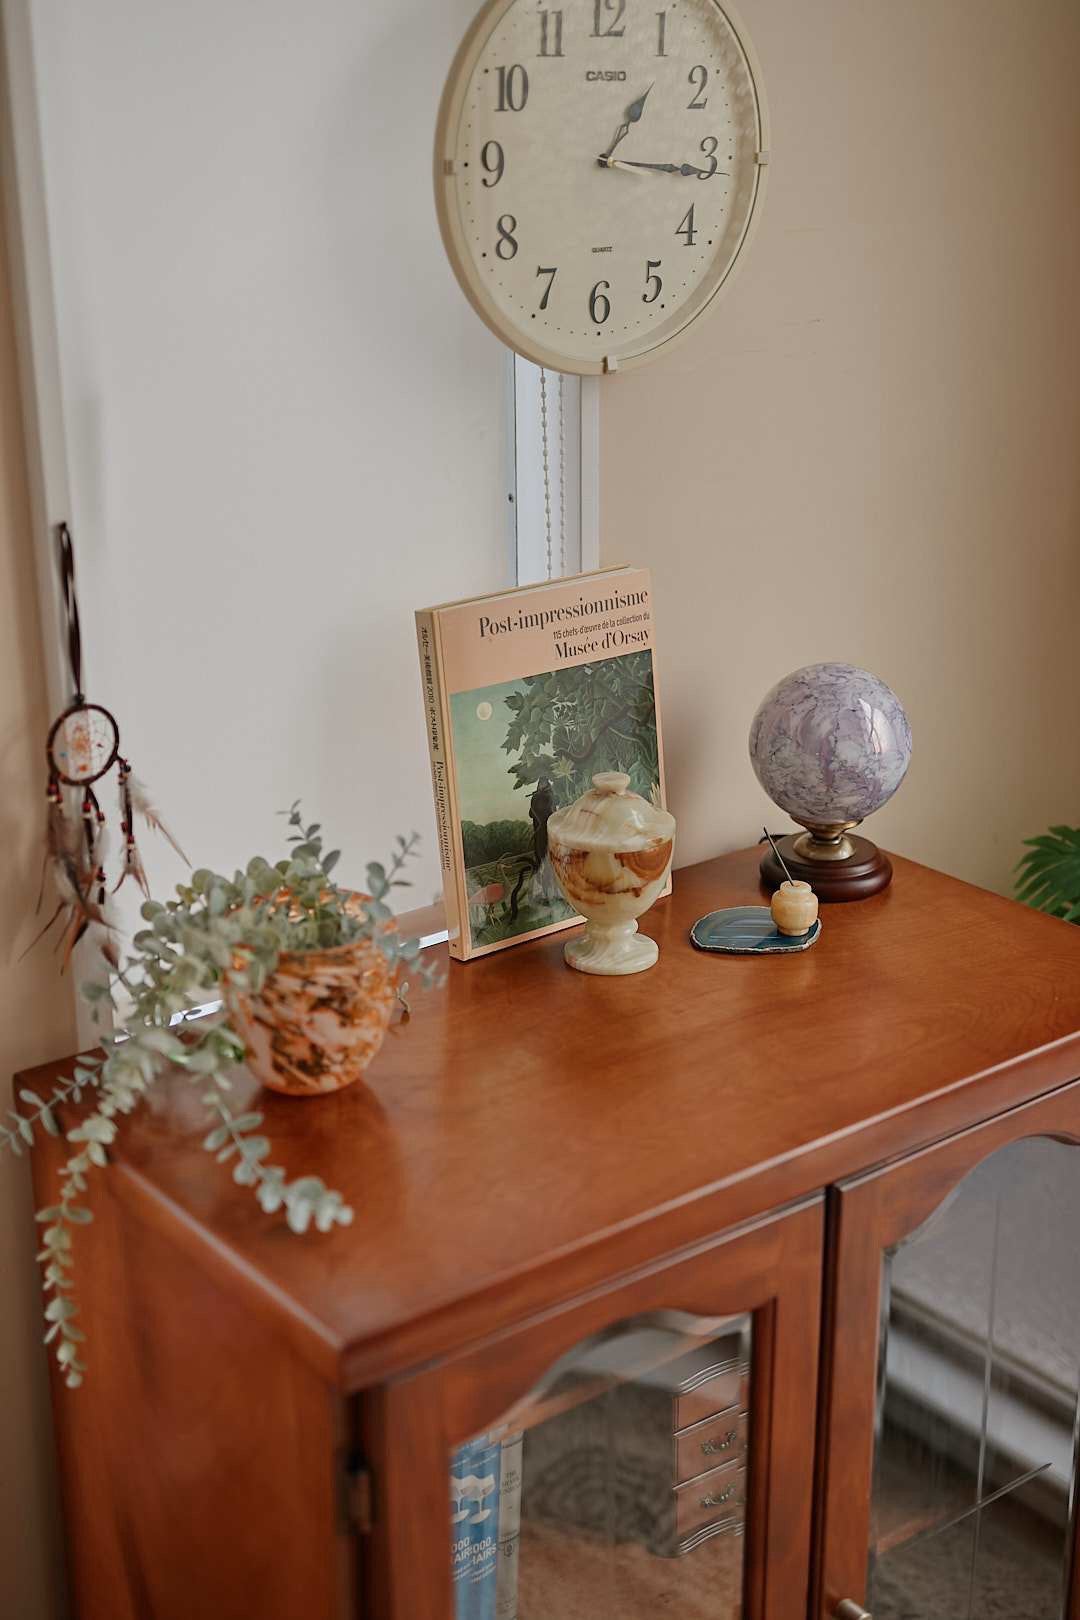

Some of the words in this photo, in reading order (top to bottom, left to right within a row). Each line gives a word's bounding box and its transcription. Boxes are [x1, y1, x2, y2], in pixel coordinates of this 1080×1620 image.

[536, 10, 565, 57] 11
[589, 0, 626, 38] 12
[654, 11, 669, 57] 1
[494, 64, 530, 113] 10
[586, 71, 627, 82] CASIO
[686, 65, 709, 110] 2
[481, 140, 505, 188] 9
[696, 136, 719, 180] 3
[495, 214, 519, 260] 8
[675, 202, 698, 247] 4
[536, 265, 558, 311] 7
[588, 280, 611, 325] 6
[641, 260, 663, 303] 5
[479, 590, 649, 638] Post-impressionnisme
[602, 620, 609, 629] de
[610, 619, 616, 628] la
[616, 613, 643, 627] collection
[555, 636, 598, 658] Musée
[601, 630, 649, 650] d'Orsay
